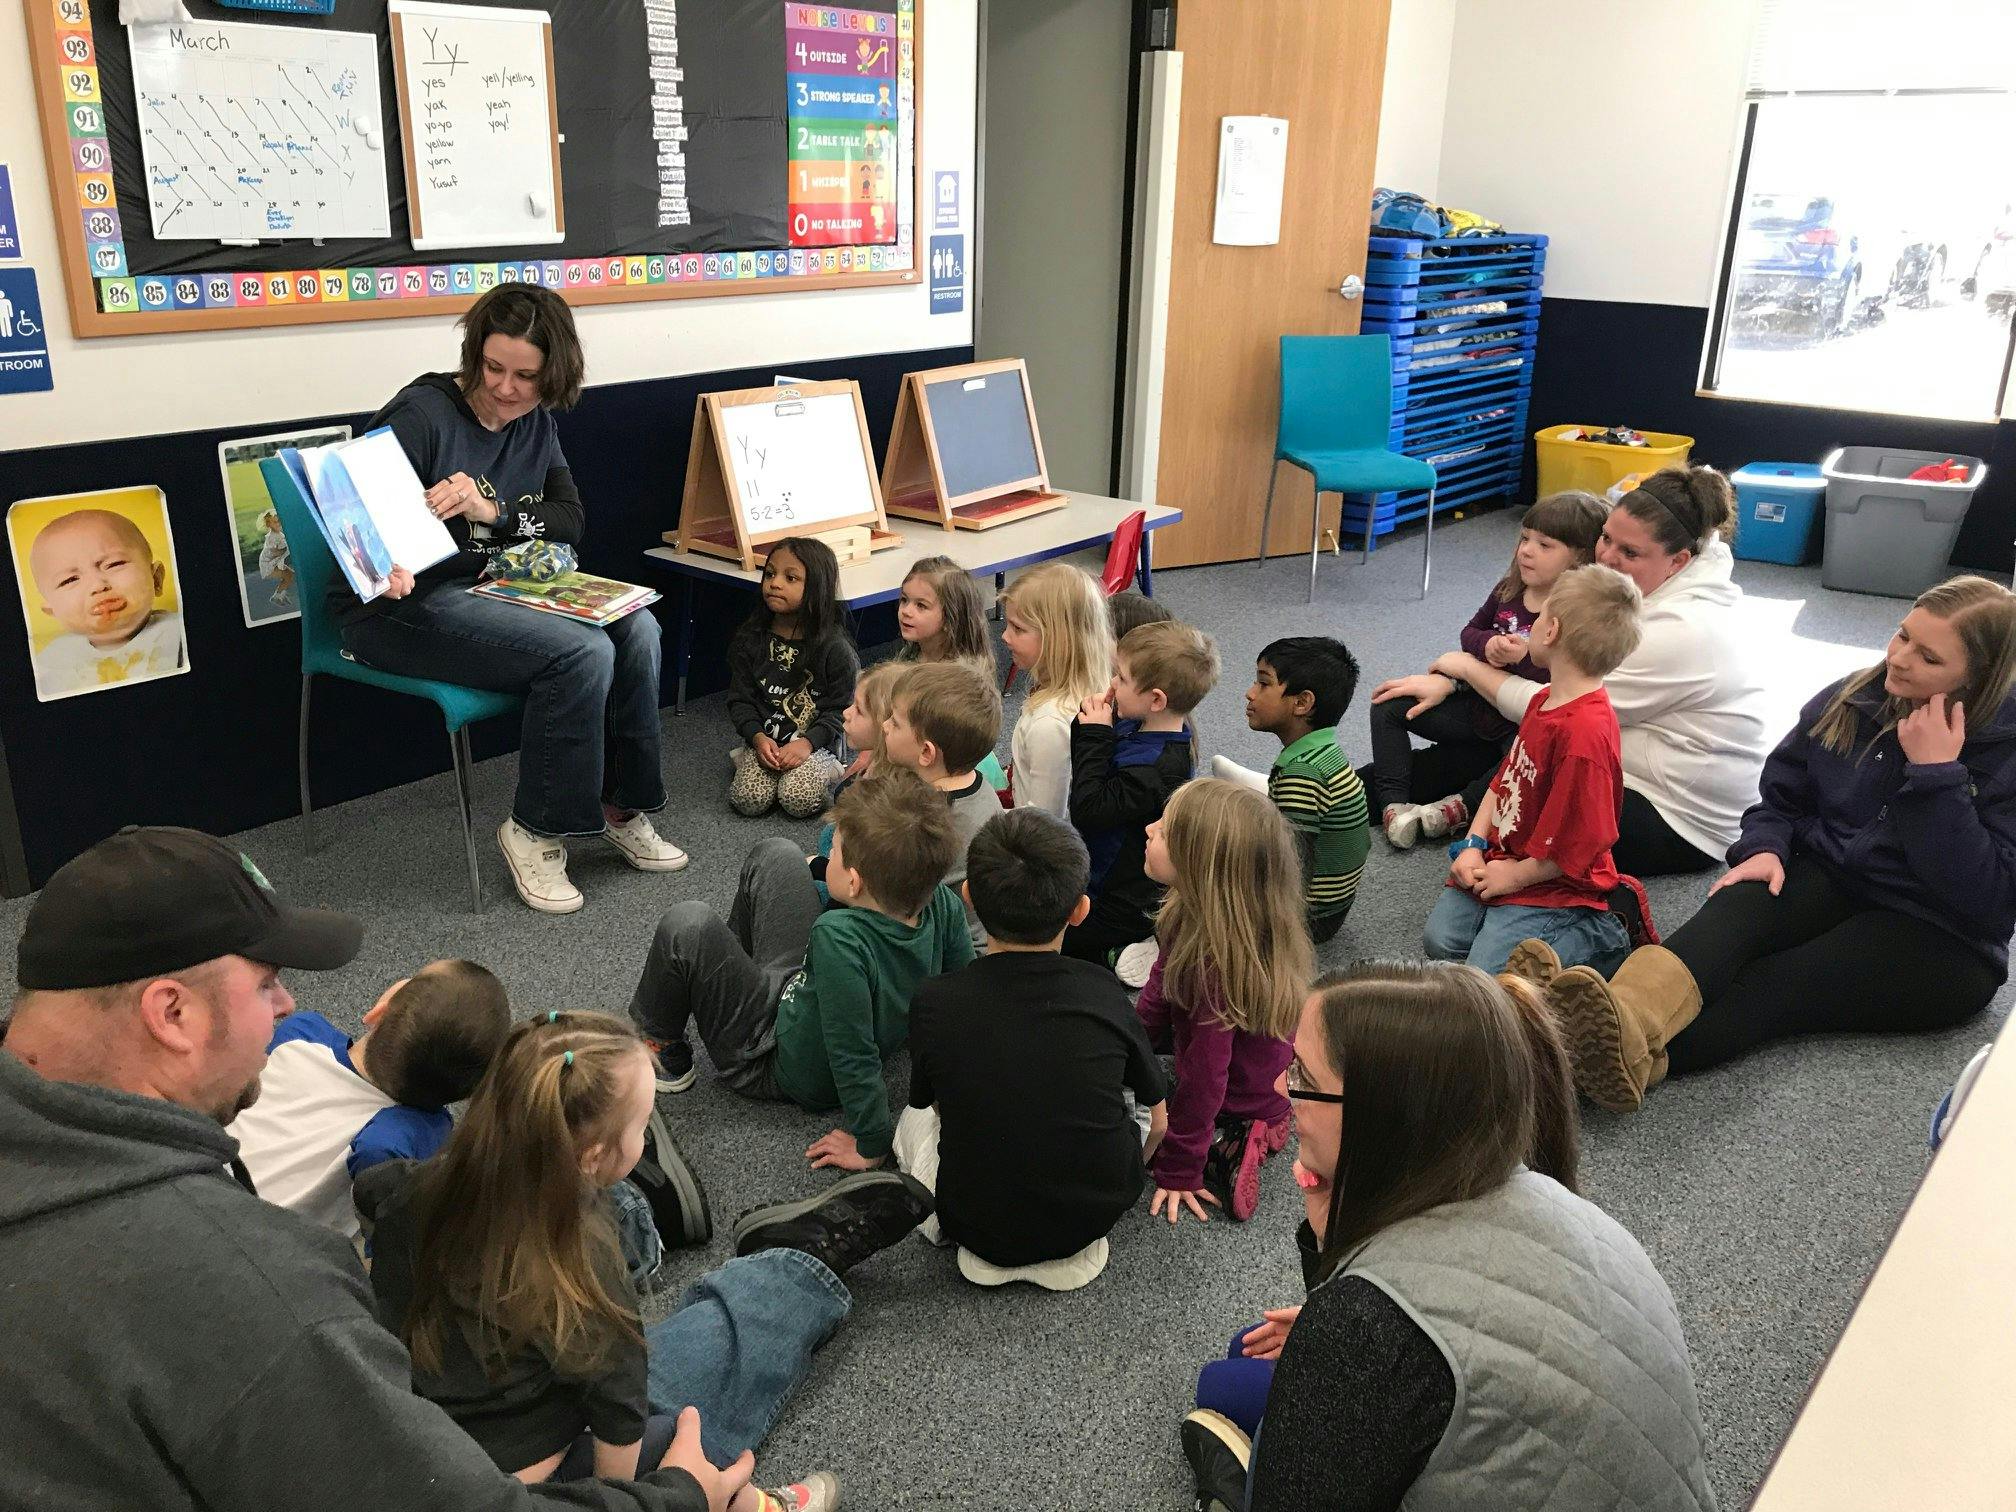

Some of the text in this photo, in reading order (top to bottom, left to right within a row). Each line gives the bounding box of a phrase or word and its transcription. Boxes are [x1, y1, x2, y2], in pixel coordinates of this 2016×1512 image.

[61, 0, 82, 20] 94
[169, 28, 230, 51] March
[66, 40, 88, 59] 93
[795, 42, 847, 66] 4 OUTSIDE
[70, 74, 92, 92] 92
[422, 78, 446, 97] yes
[199, 95, 205, 103] 5
[796, 82, 876, 106] 3 STRONG SPEAKER
[424, 99, 511, 118] yak yeah
[77, 110, 96, 128] 91
[335, 109, 350, 129] W
[424, 120, 453, 134] yo-yo
[231, 131, 239, 139] 13
[259, 133, 266, 141] 14
[797, 127, 860, 150] 2 TABLE TALK
[341, 144, 352, 162] X
[426, 138, 454, 154] yellow
[82, 146, 103, 165] 90
[428, 157, 451, 170] yarn
[149, 165, 158, 173] 17
[153, 173, 180, 187] August
[343, 171, 355, 190] Y
[429, 175, 459, 189] Yusuf
[800, 170, 808, 192] 1
[87, 182, 107, 201] 89
[267, 201, 277, 209] 28
[91, 217, 112, 234] 88
[794, 213, 863, 237] 0 NO TALKING
[97, 251, 116, 268] 87
[109, 286, 130, 304] 86
[145, 285, 165, 302] 85
[178, 283, 199, 300] 84
[211, 282, 230, 299] 83
[242, 280, 260, 297] 82
[272, 278, 289, 296] 81
[299, 278, 316, 295] 80
[326, 277, 343, 294] 79
[354, 276, 370, 292] 78
[380, 275, 396, 291] 77
[406, 273, 421, 290] 76
[432, 273, 446, 289] 75
[457, 270, 471, 286] 74
[480, 270, 493, 286] 73
[504, 269, 517, 282] 72
[524, 268, 537, 283] 71
[547, 267, 560, 282] 70
[568, 267, 581, 281] 69
[588, 266, 601, 280] 68
[610, 263, 622, 277] 67
[630, 264, 643, 278] 66
[650, 262, 662, 276] 65
[668, 261, 680, 275] 64
[686, 261, 698, 275] 63
[705, 259, 717, 273] 62
[723, 260, 734, 274] 61
[741, 259, 752, 273] 60
[758, 257, 769, 271] 59
[775, 256, 786, 270] 58
[809, 254, 820, 269] 56
[825, 254, 835, 268] 55
[841, 252, 851, 266] 54
[933, 290, 962, 300] RESTROOM
